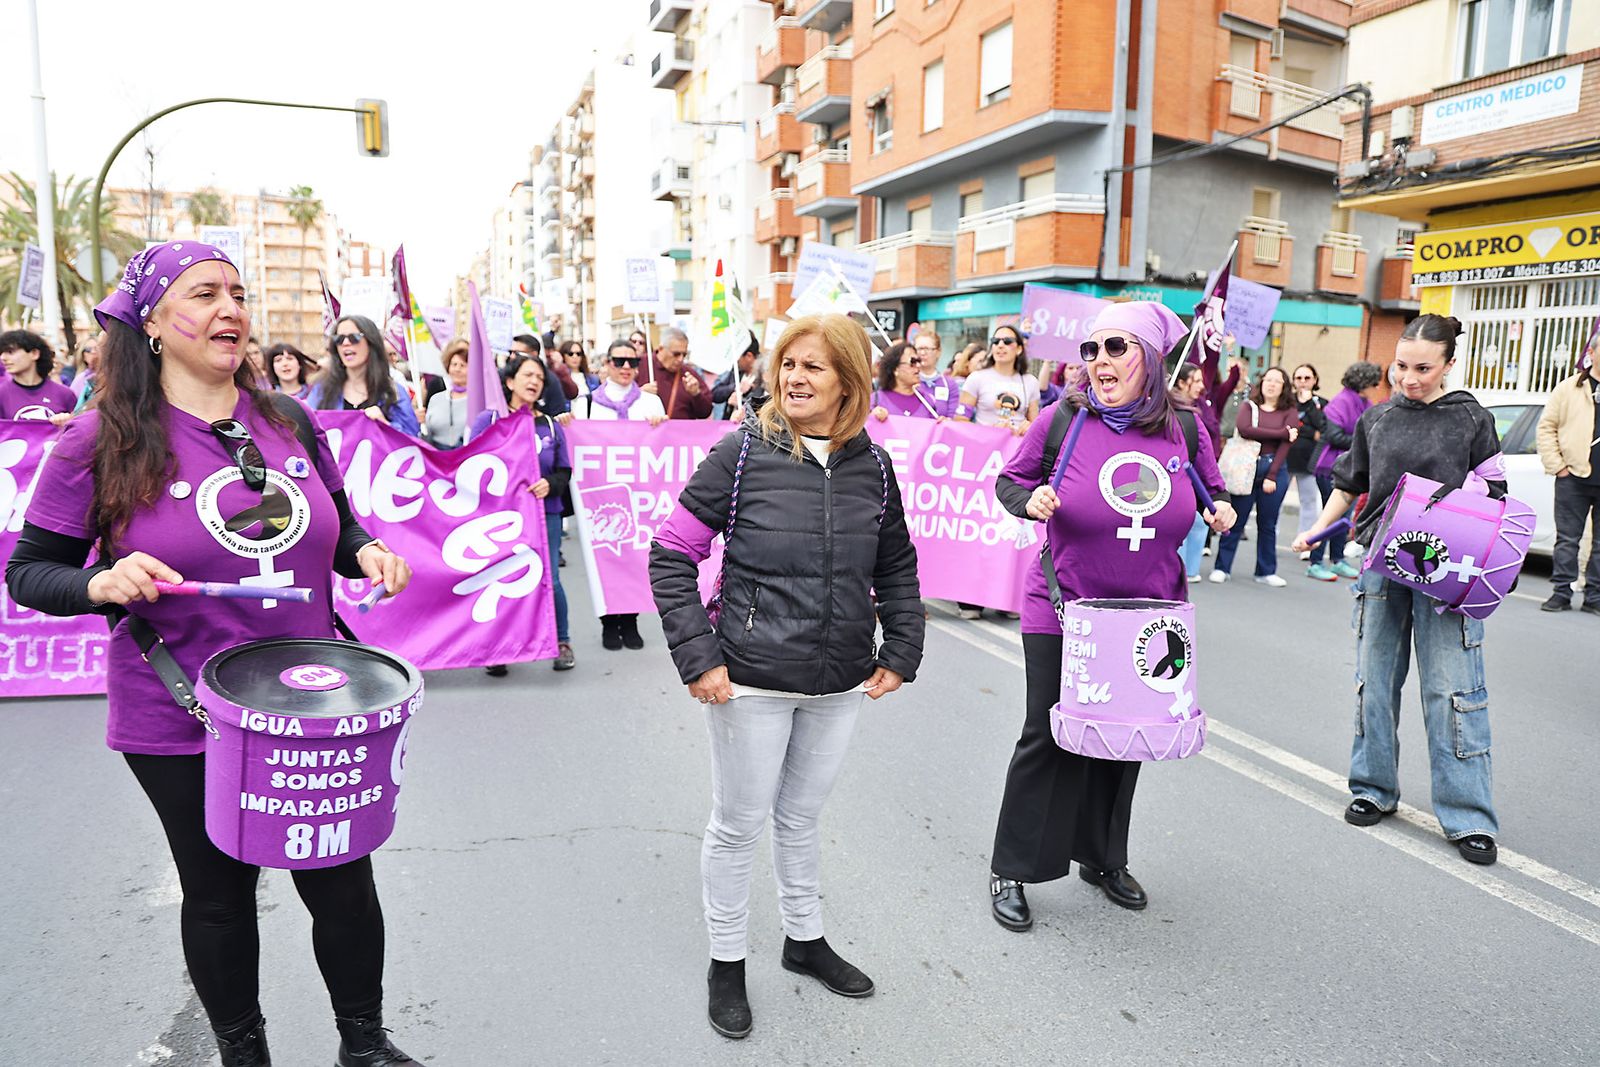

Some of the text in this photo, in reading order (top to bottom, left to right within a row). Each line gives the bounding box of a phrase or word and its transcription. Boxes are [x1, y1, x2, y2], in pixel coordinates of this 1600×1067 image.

[1436, 93, 1494, 119] CENTRO
[1499, 75, 1567, 104] MÉDICO
[1420, 234, 1524, 261] COMPRO
[1439, 271, 1460, 283] 959
[1460, 269, 1482, 281] 813
[1483, 266, 1505, 280] 007
[1552, 260, 1577, 275] 645
[897, 480, 1008, 521] IONA
[237, 543, 259, 554] para
[260, 541, 285, 554] tanta
[1135, 615, 1168, 656] HABRÁ
[299, 668, 331, 683] 8M
[1136, 658, 1150, 677] NO
[379, 704, 403, 730] DE
[264, 745, 369, 768] JUNTAS
[270, 768, 363, 791] SOMOS
[240, 784, 383, 817] IMPARABLES
[284, 818, 352, 861] 8M
